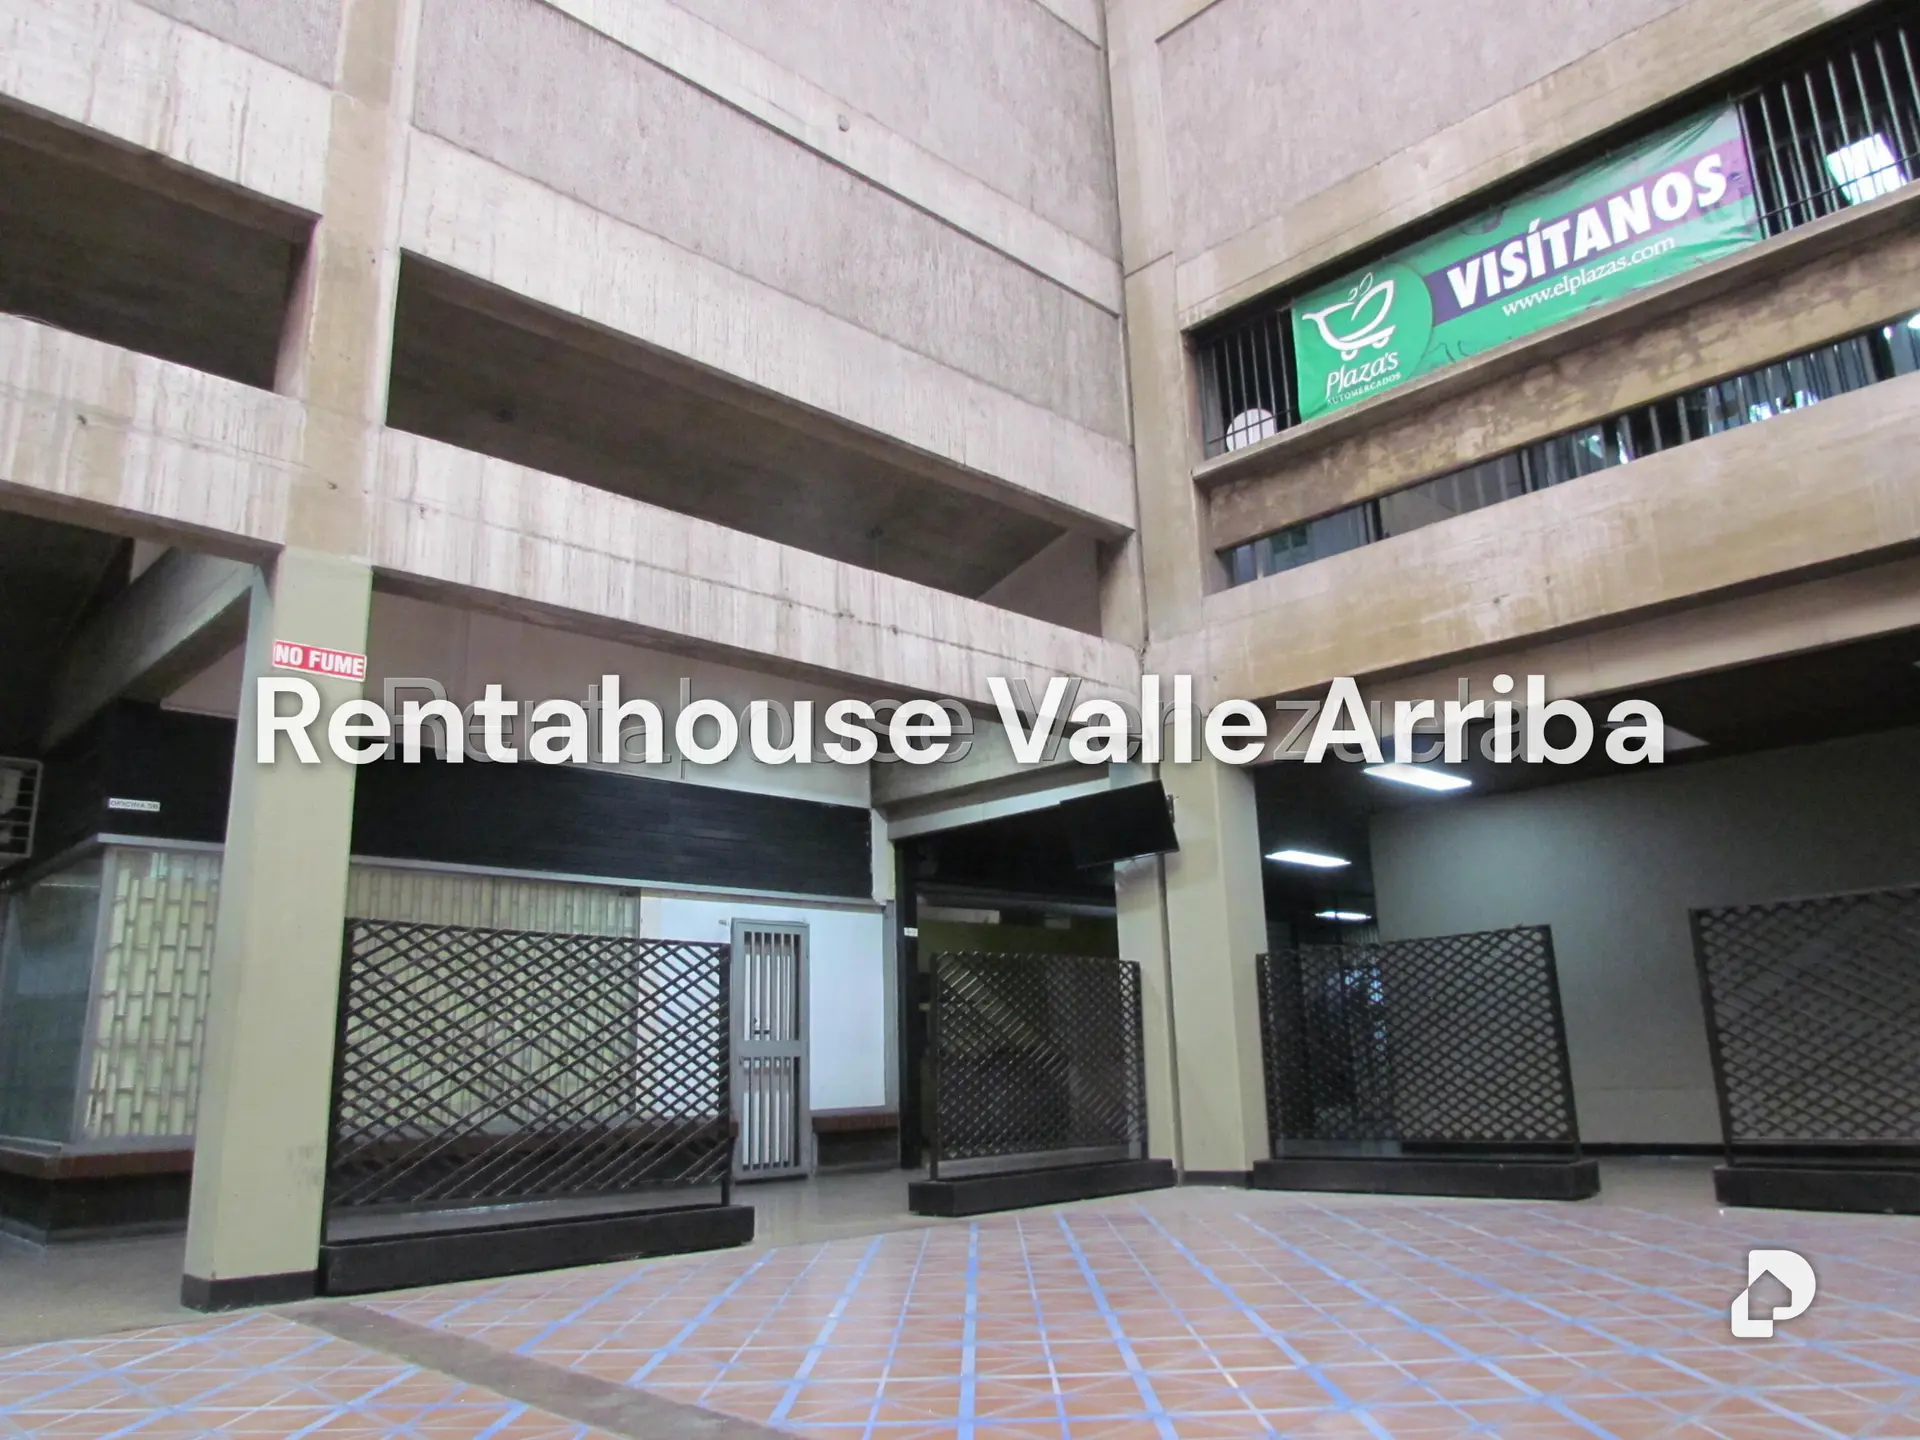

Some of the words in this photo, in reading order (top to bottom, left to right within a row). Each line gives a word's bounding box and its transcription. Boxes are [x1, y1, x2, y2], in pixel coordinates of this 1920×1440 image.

[1446, 153, 1727, 309] VISÍTANOS
[1501, 236, 1675, 317] www.elplazas.com
[1326, 352, 1399, 400] Plaza's
[1327, 371, 1402, 406] AUTOMERCADOS
[275, 644, 304, 666] NO
[308, 650, 364, 676] FUME
